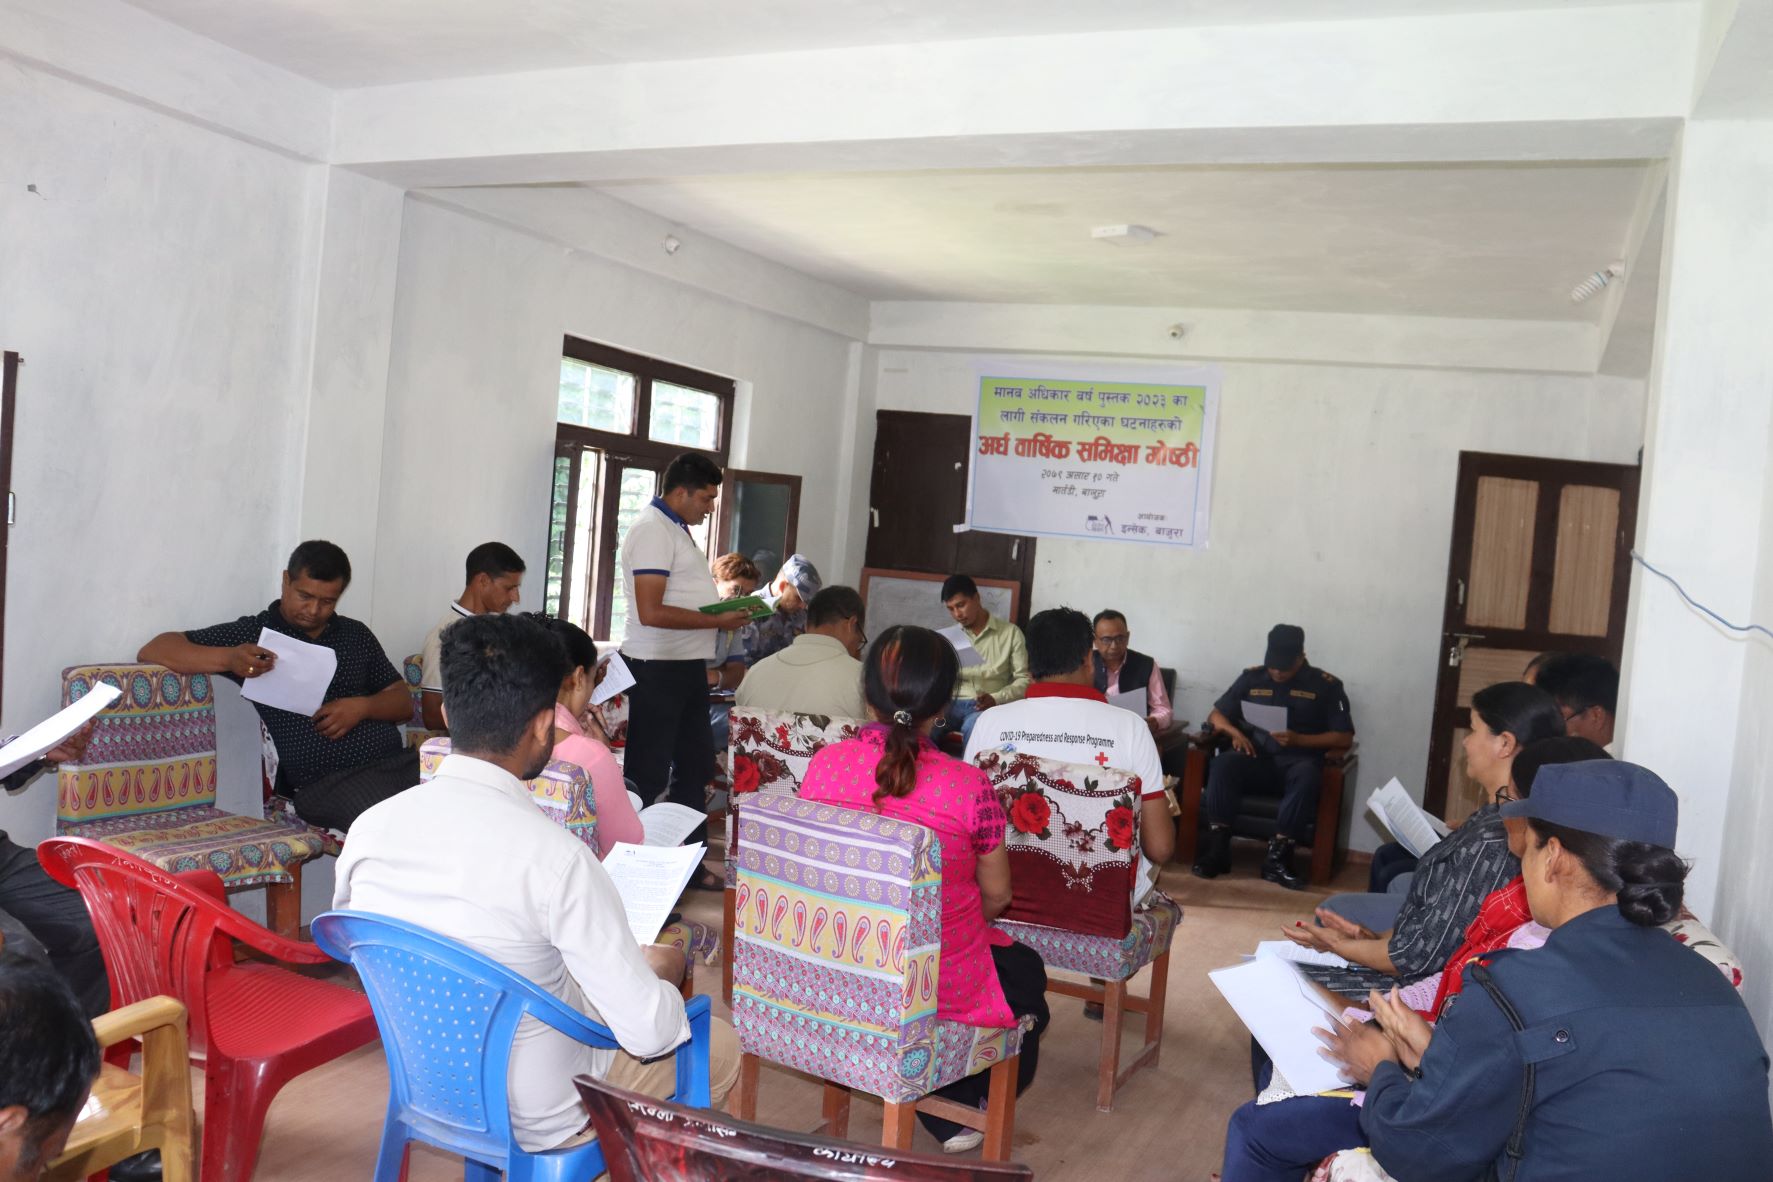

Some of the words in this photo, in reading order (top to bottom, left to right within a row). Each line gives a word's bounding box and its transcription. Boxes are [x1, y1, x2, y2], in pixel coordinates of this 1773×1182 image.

[994, 386, 1023, 399] मानव
[1028, 384, 1072, 401] अधिकार
[1076, 387, 1093, 401] वर्ष
[1098, 391, 1131, 408] पुस्तक
[1137, 393, 1167, 408] २०२३
[1172, 395, 1188, 406] का
[1000, 407, 1025, 423] लागी
[1030, 409, 1069, 424] संकलन
[1073, 410, 1115, 430] गरिएका
[1120, 415, 1183, 432] घटनाहरुको
[1014, 431, 1073, 459] वार्षिक
[1076, 435, 1142, 466] समिक्षा
[1145, 439, 1200, 468] गोष्ठी
[1041, 469, 1063, 479] २०७९
[1066, 470, 1091, 480] असार
[1106, 471, 1120, 481] गते
[1082, 488, 1107, 500] बाजुरा
[1155, 526, 1184, 539] बाजुरा
[1000, 730, 1020, 742] COVID-19
[1021, 730, 1053, 744] Preparedness
[1054, 732, 1064, 743] and
[1064, 732, 1085, 746] Response
[1086, 734, 1115, 749] Programme
